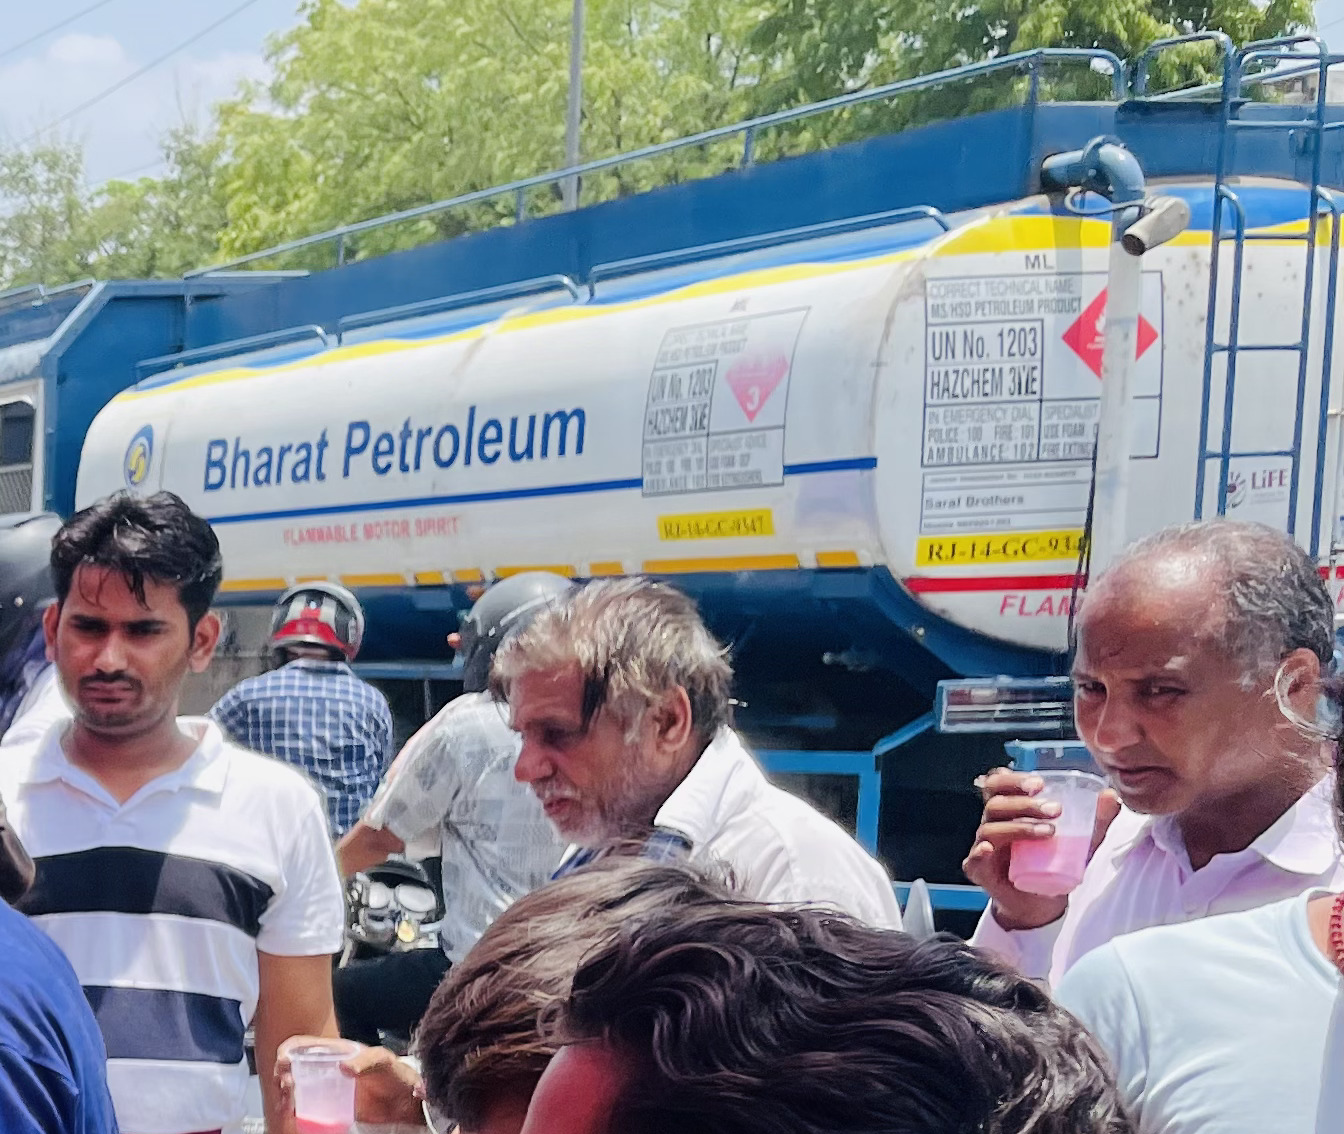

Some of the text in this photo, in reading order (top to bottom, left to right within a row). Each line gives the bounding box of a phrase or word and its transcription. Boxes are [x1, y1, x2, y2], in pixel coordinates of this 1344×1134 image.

[929, 277, 1074, 299] CORRECT TECHNICAL NAME
[974, 298, 1035, 317] PETROLEUM
[1037, 296, 1082, 314] PRODUCT
[932, 326, 1038, 361] UN No. 1203
[930, 367, 1004, 399] HAZCHEM
[943, 407, 1009, 425] EMERGENCY
[203, 404, 587, 493] Bharat Petroleum
[362, 519, 410, 541] MOTOR
